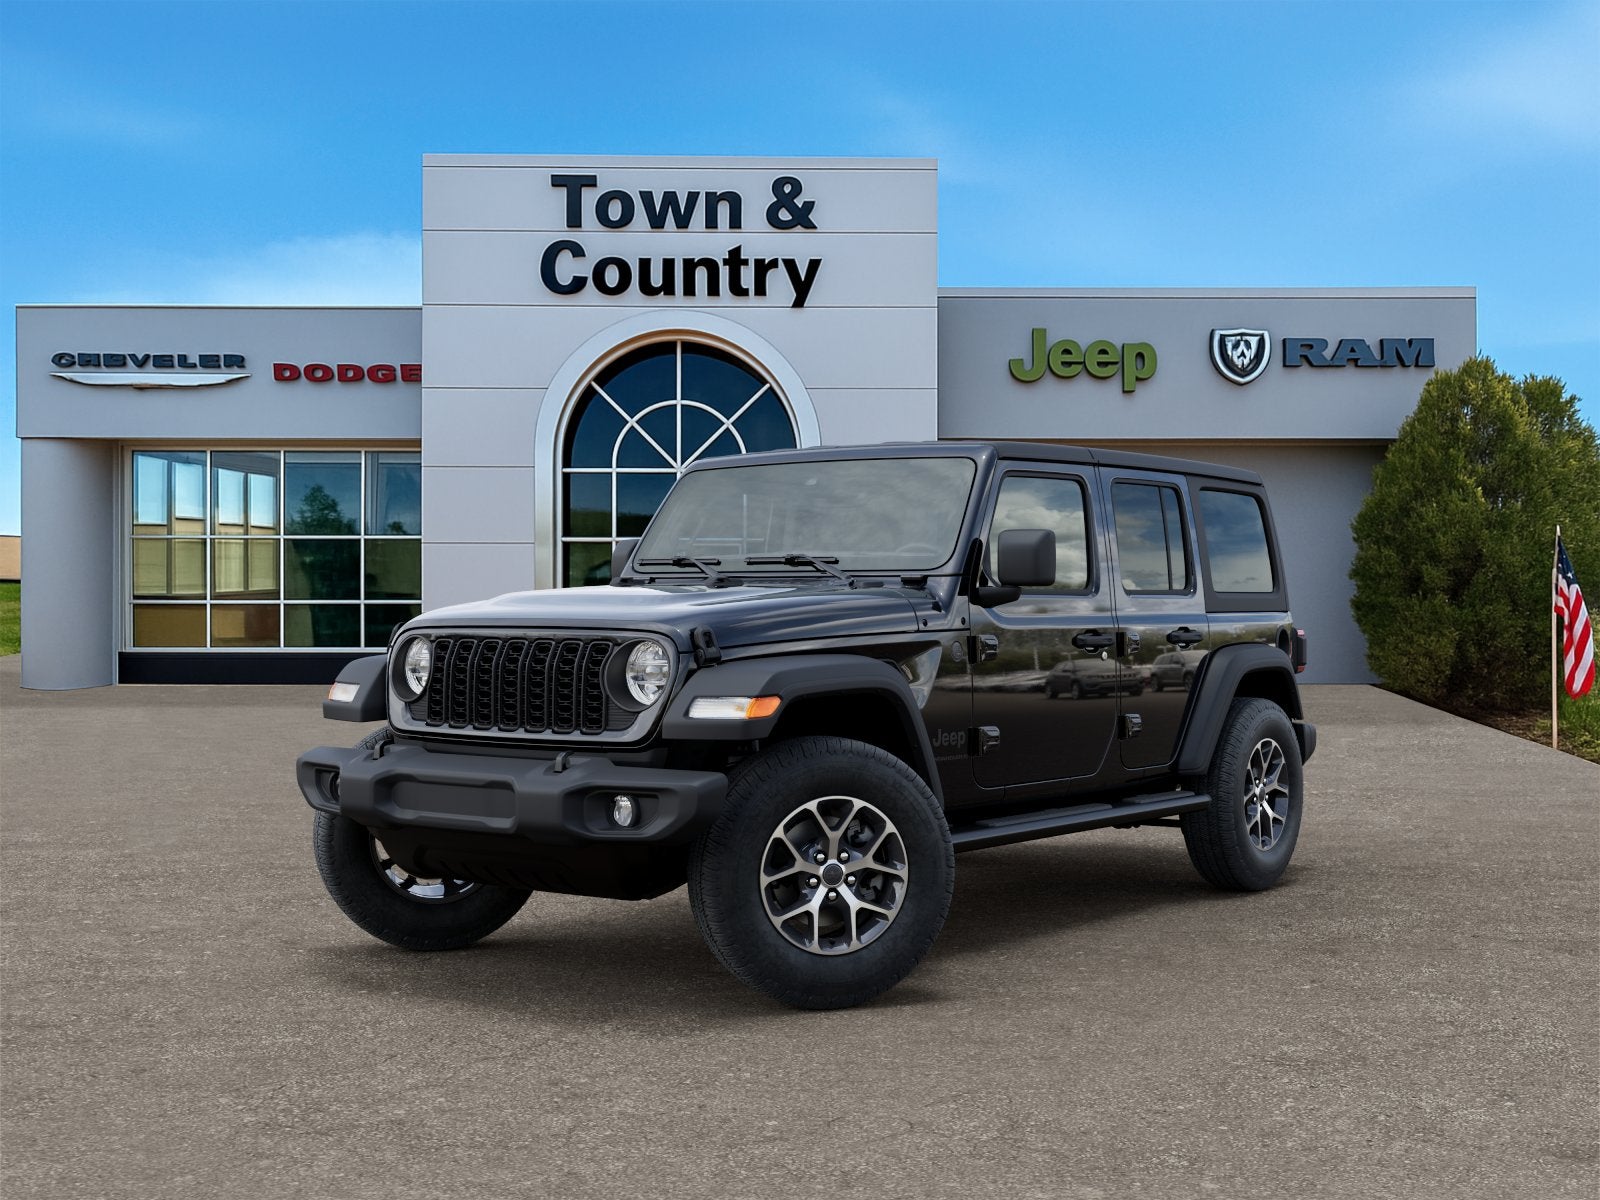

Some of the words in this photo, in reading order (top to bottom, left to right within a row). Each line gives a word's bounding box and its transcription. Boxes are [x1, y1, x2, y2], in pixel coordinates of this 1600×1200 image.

[550, 174, 742, 229] Town
[765, 176, 818, 230] &
[540, 239, 822, 308] Country
[272, 362, 422, 383] DODGE
[1008, 327, 1158, 393] Jeep
[1282, 337, 1435, 368] RAM
[932, 728, 966, 748] Jeep
